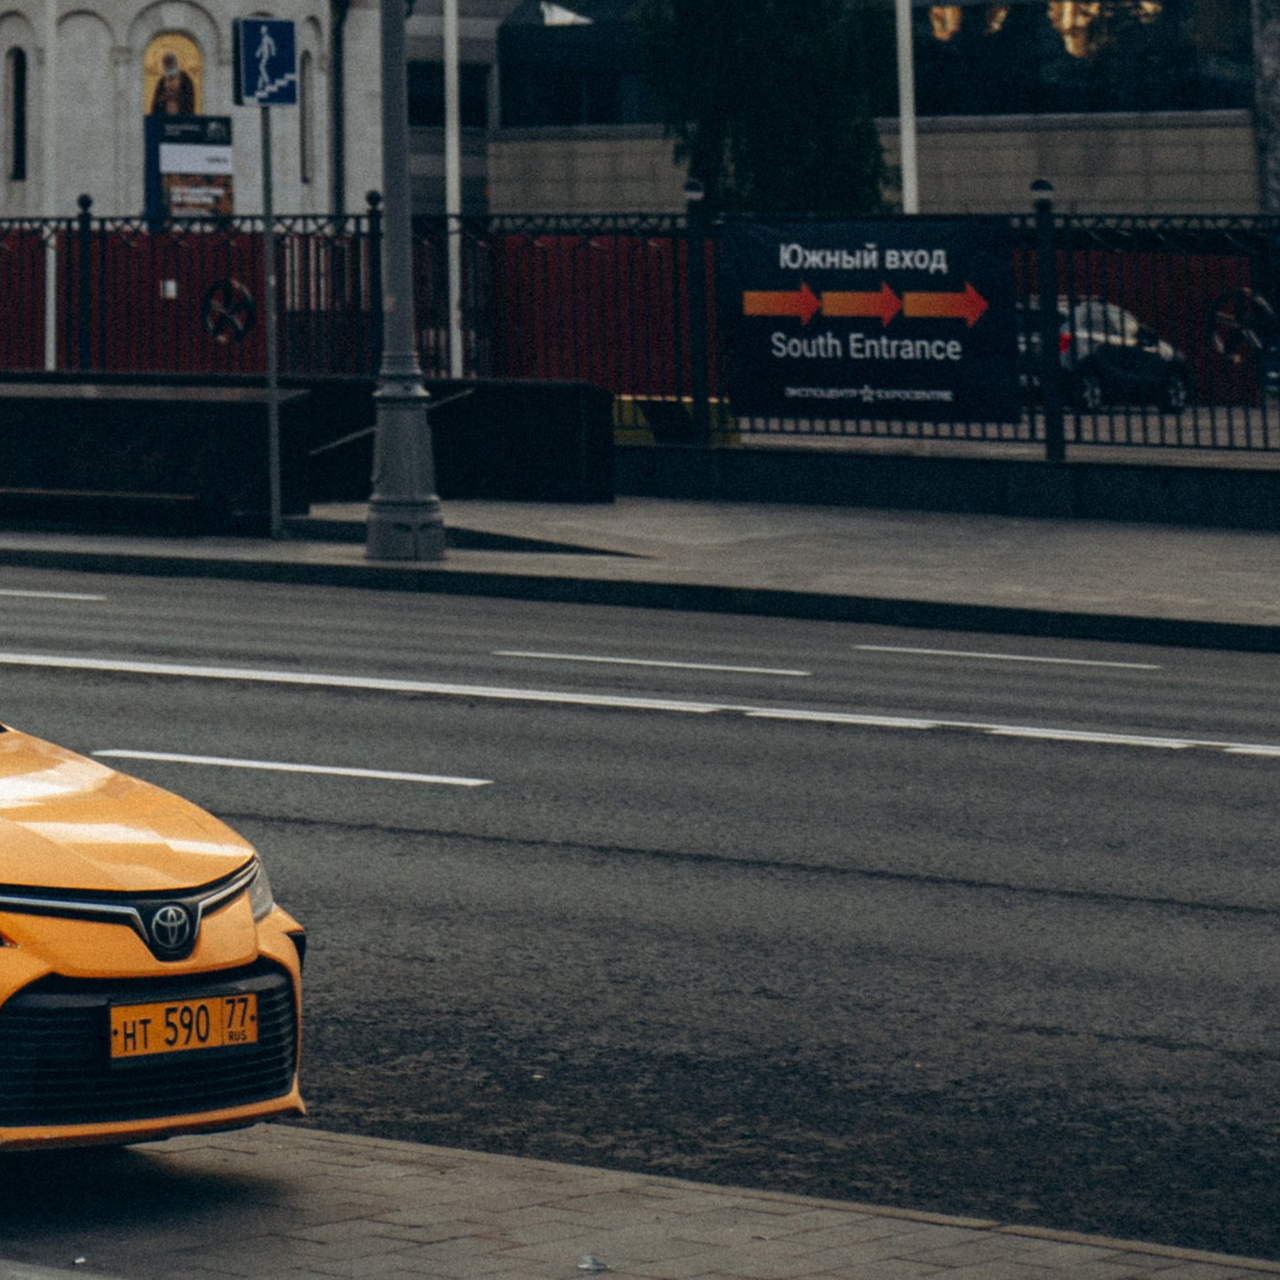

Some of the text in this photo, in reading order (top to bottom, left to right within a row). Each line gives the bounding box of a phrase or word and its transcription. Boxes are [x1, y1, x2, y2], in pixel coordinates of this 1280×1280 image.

[779, 242, 949, 275] Южный вход
[771, 331, 963, 361] South Entrance
[164, 1004, 210, 1047] 590
[225, 997, 249, 1030] 77
[228, 1030, 248, 1042] RUS
